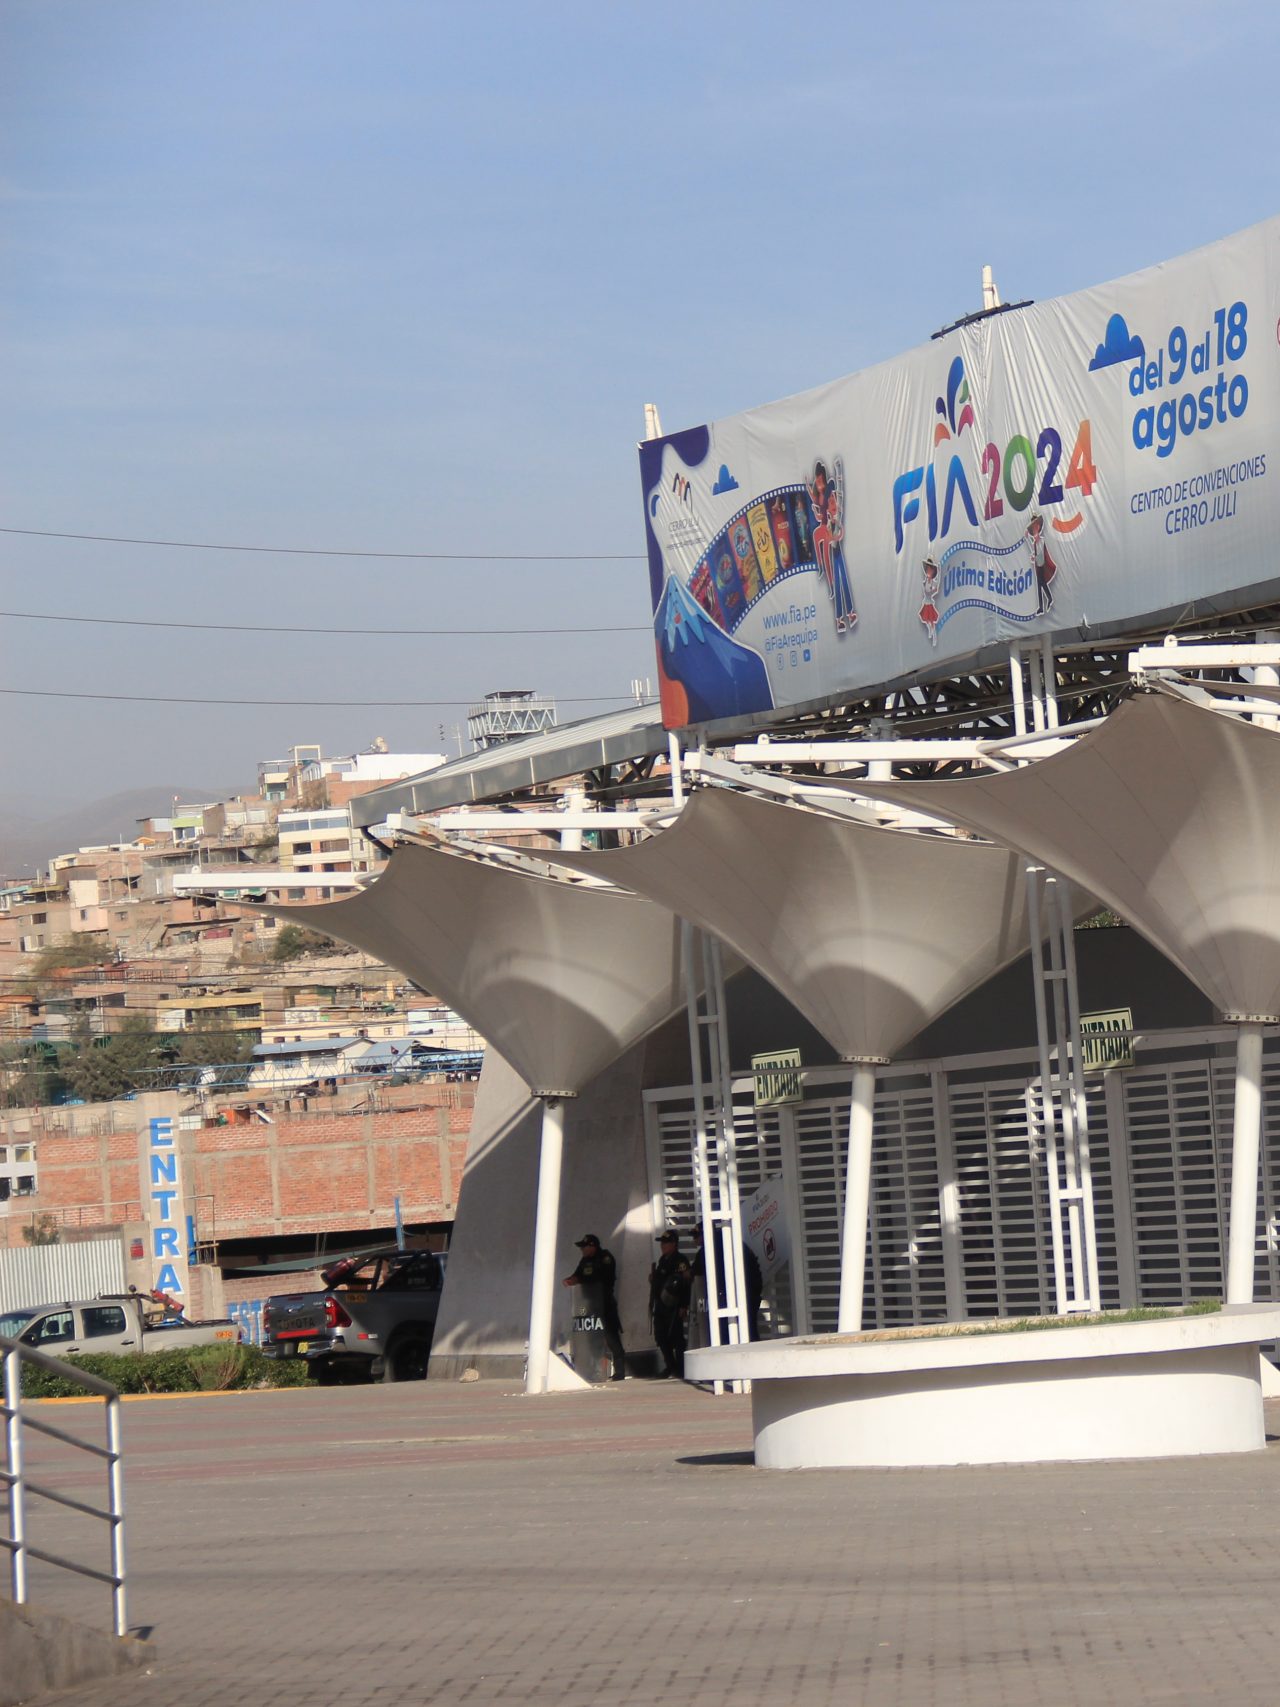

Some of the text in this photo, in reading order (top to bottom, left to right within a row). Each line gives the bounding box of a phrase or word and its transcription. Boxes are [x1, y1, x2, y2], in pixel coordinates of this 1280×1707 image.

[1129, 301, 1248, 397] del 9 al 18
[1132, 372, 1249, 458] agosto
[893, 419, 1097, 554] FIA 2024
[1130, 454, 1267, 514] CENTRO DE CONVENCIONES
[1165, 491, 1237, 535] CERRO JULI
[943, 560, 1033, 598] Última Edición
[763, 604, 816, 630] www.fia.pe
[764, 628, 818, 653] @FiaArequipa
[755, 1058, 800, 1100] ENTRADA
[149, 1116, 183, 1325] ENTRA
